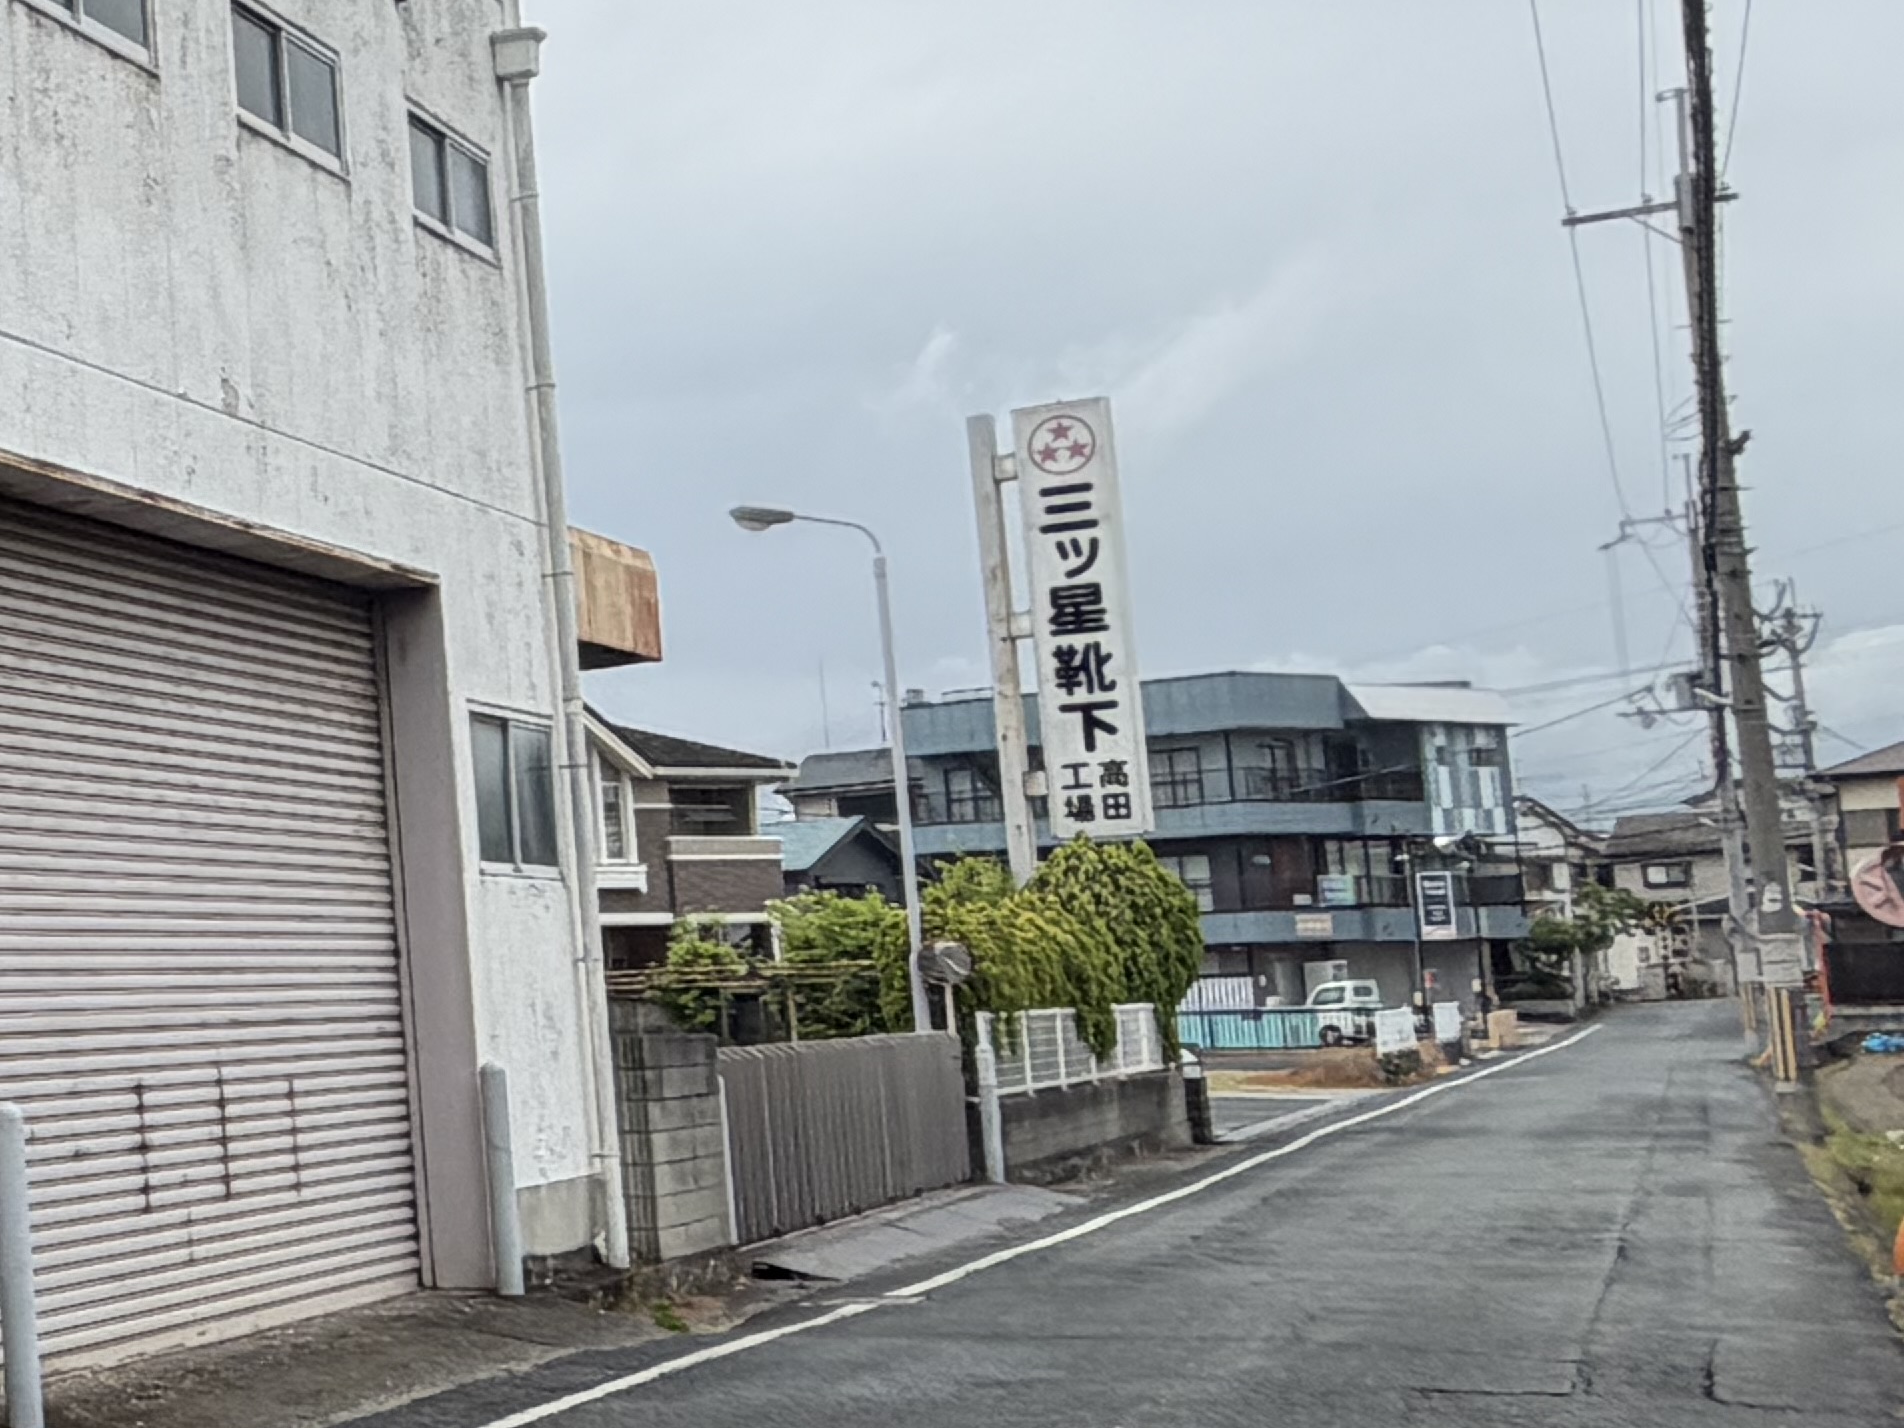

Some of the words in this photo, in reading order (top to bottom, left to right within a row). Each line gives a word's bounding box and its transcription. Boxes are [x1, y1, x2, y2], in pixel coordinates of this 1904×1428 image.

[1038, 482, 1118, 752] 三ツ星靴下
[1060, 762, 1096, 823] 工場
[1097, 759, 1131, 820] 高田
